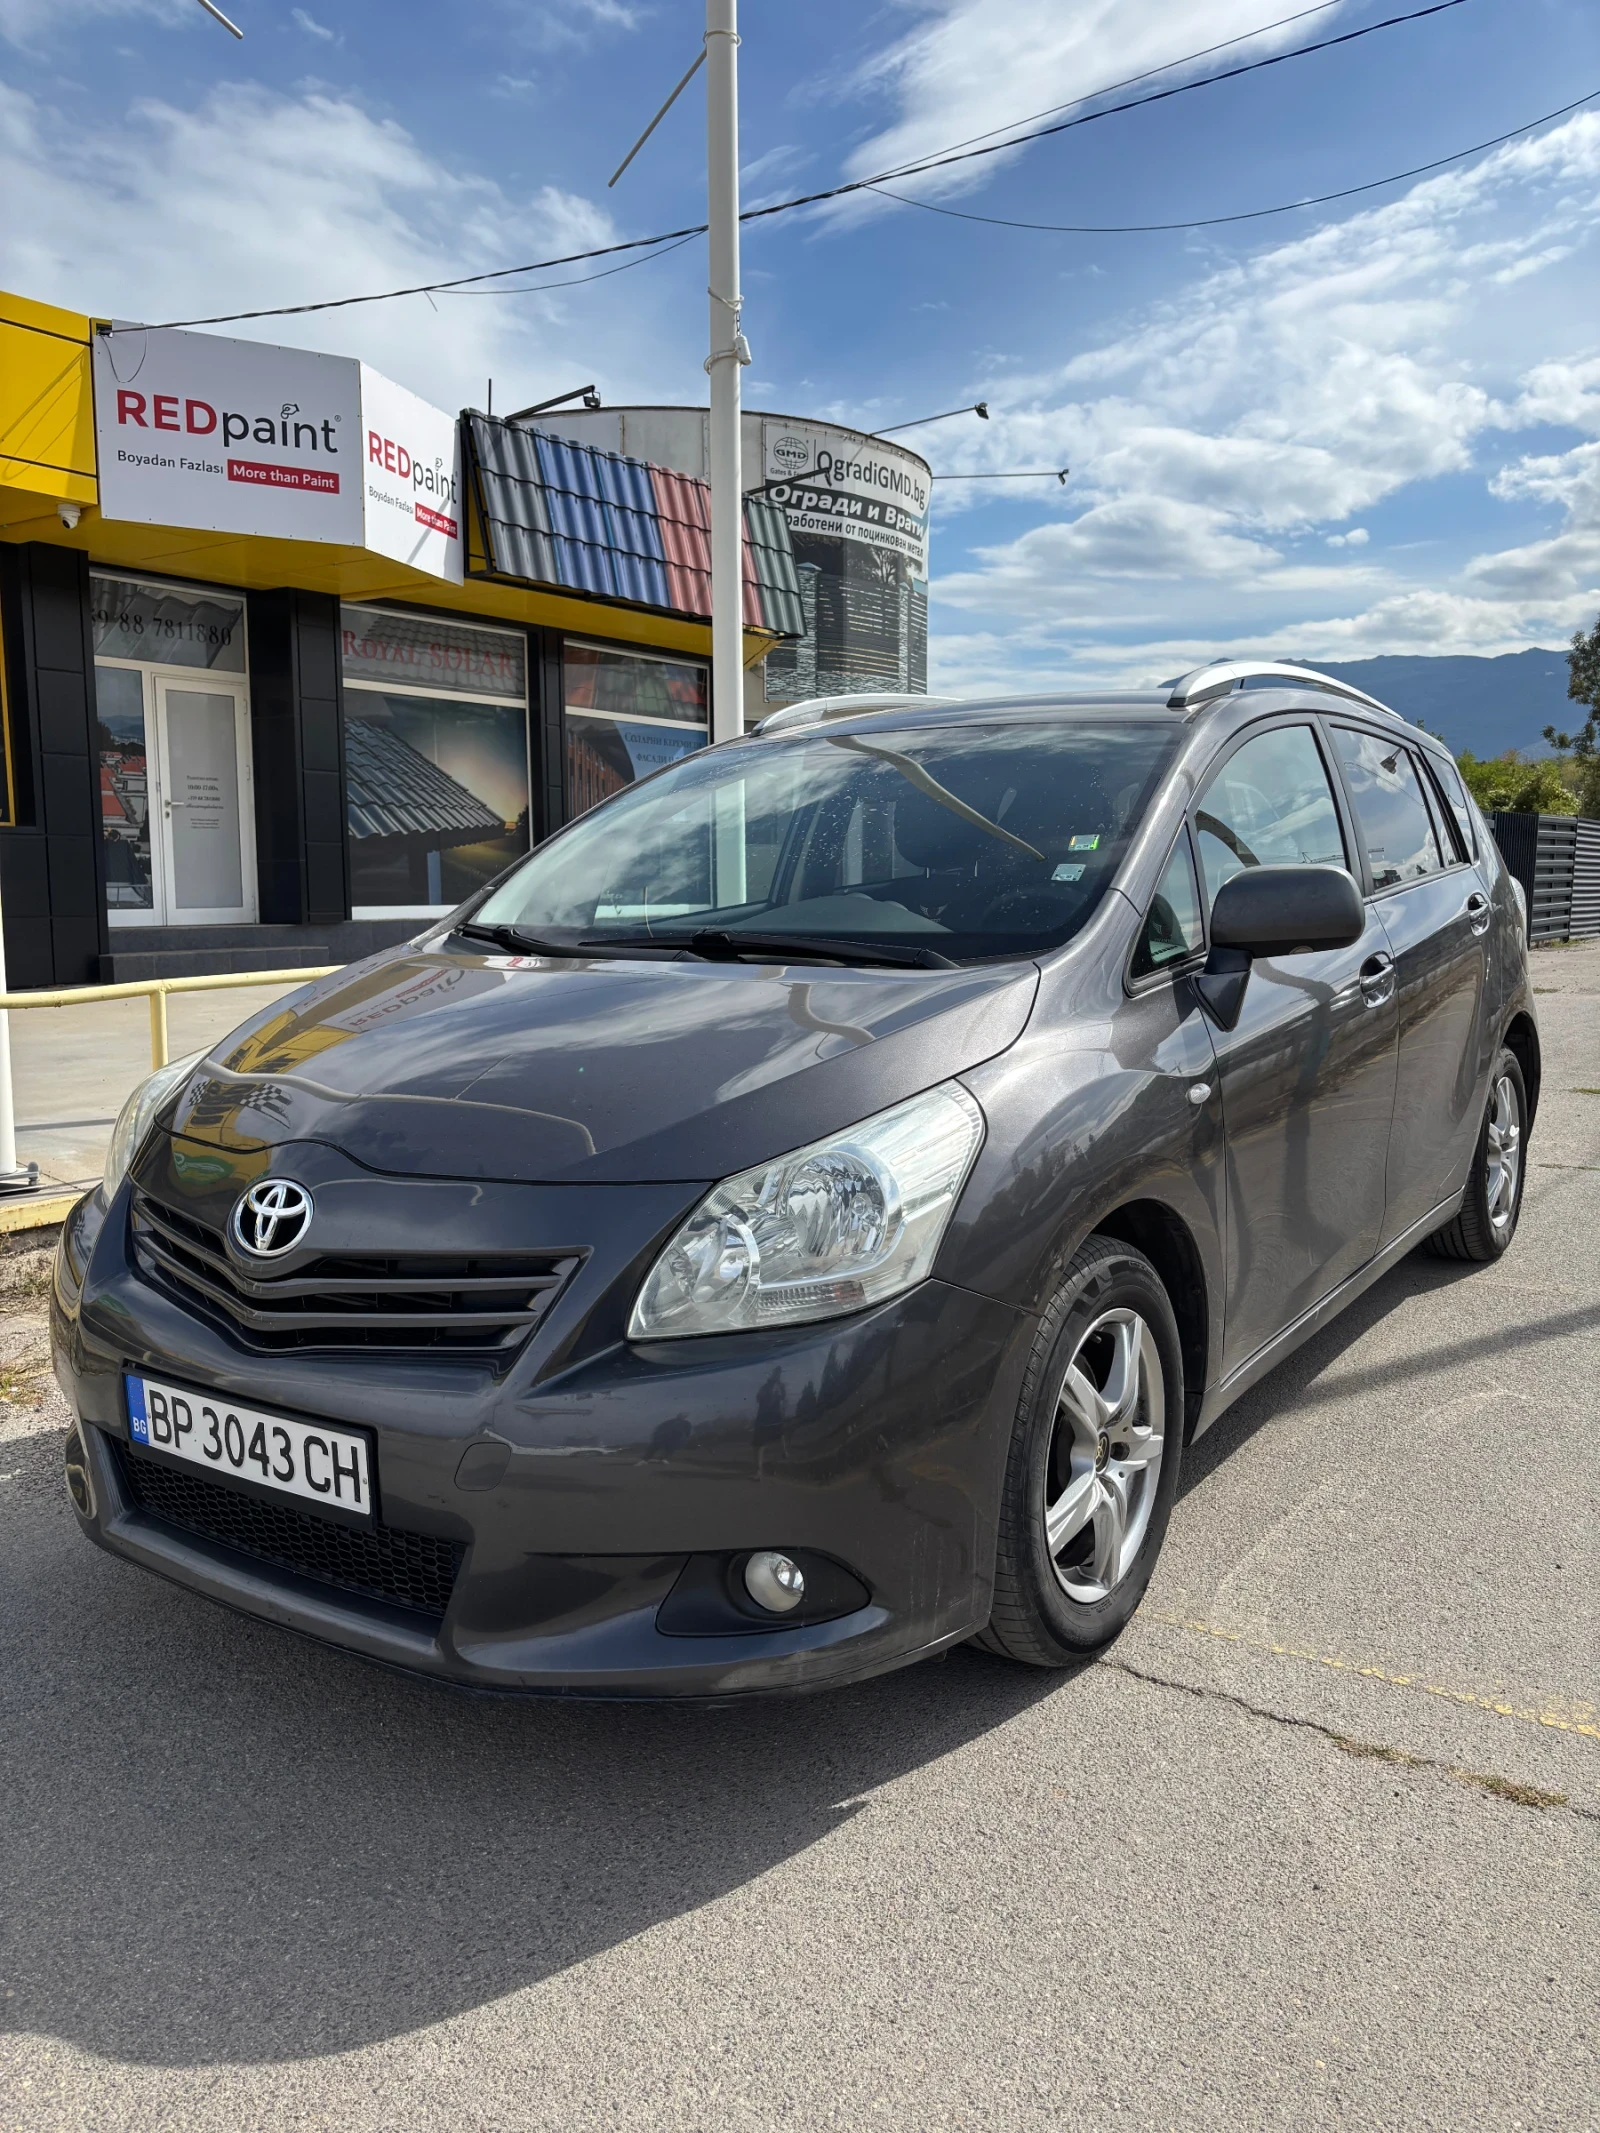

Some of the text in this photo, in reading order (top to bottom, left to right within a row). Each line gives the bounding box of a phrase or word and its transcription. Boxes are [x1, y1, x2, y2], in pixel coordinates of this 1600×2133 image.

[117, 450, 224, 475] Boyadan Fazlası
[776, 449, 806, 459] GMD
[233, 464, 335, 489] More than Paint
[368, 485, 395, 506] Boyadan
[416, 506, 431, 523] More
[443, 519, 457, 535] Paint
[769, 484, 924, 538] Огради и Врати
[787, 513, 924, 559] работени от поцинкован метал
[119, 612, 145, 635] 88
[152, 617, 232, 646] 7811880
[429, 641, 514, 678] SOLAR
[132, 1416, 147, 1434] BG
[148, 1389, 362, 1504] BP 3043 CH
